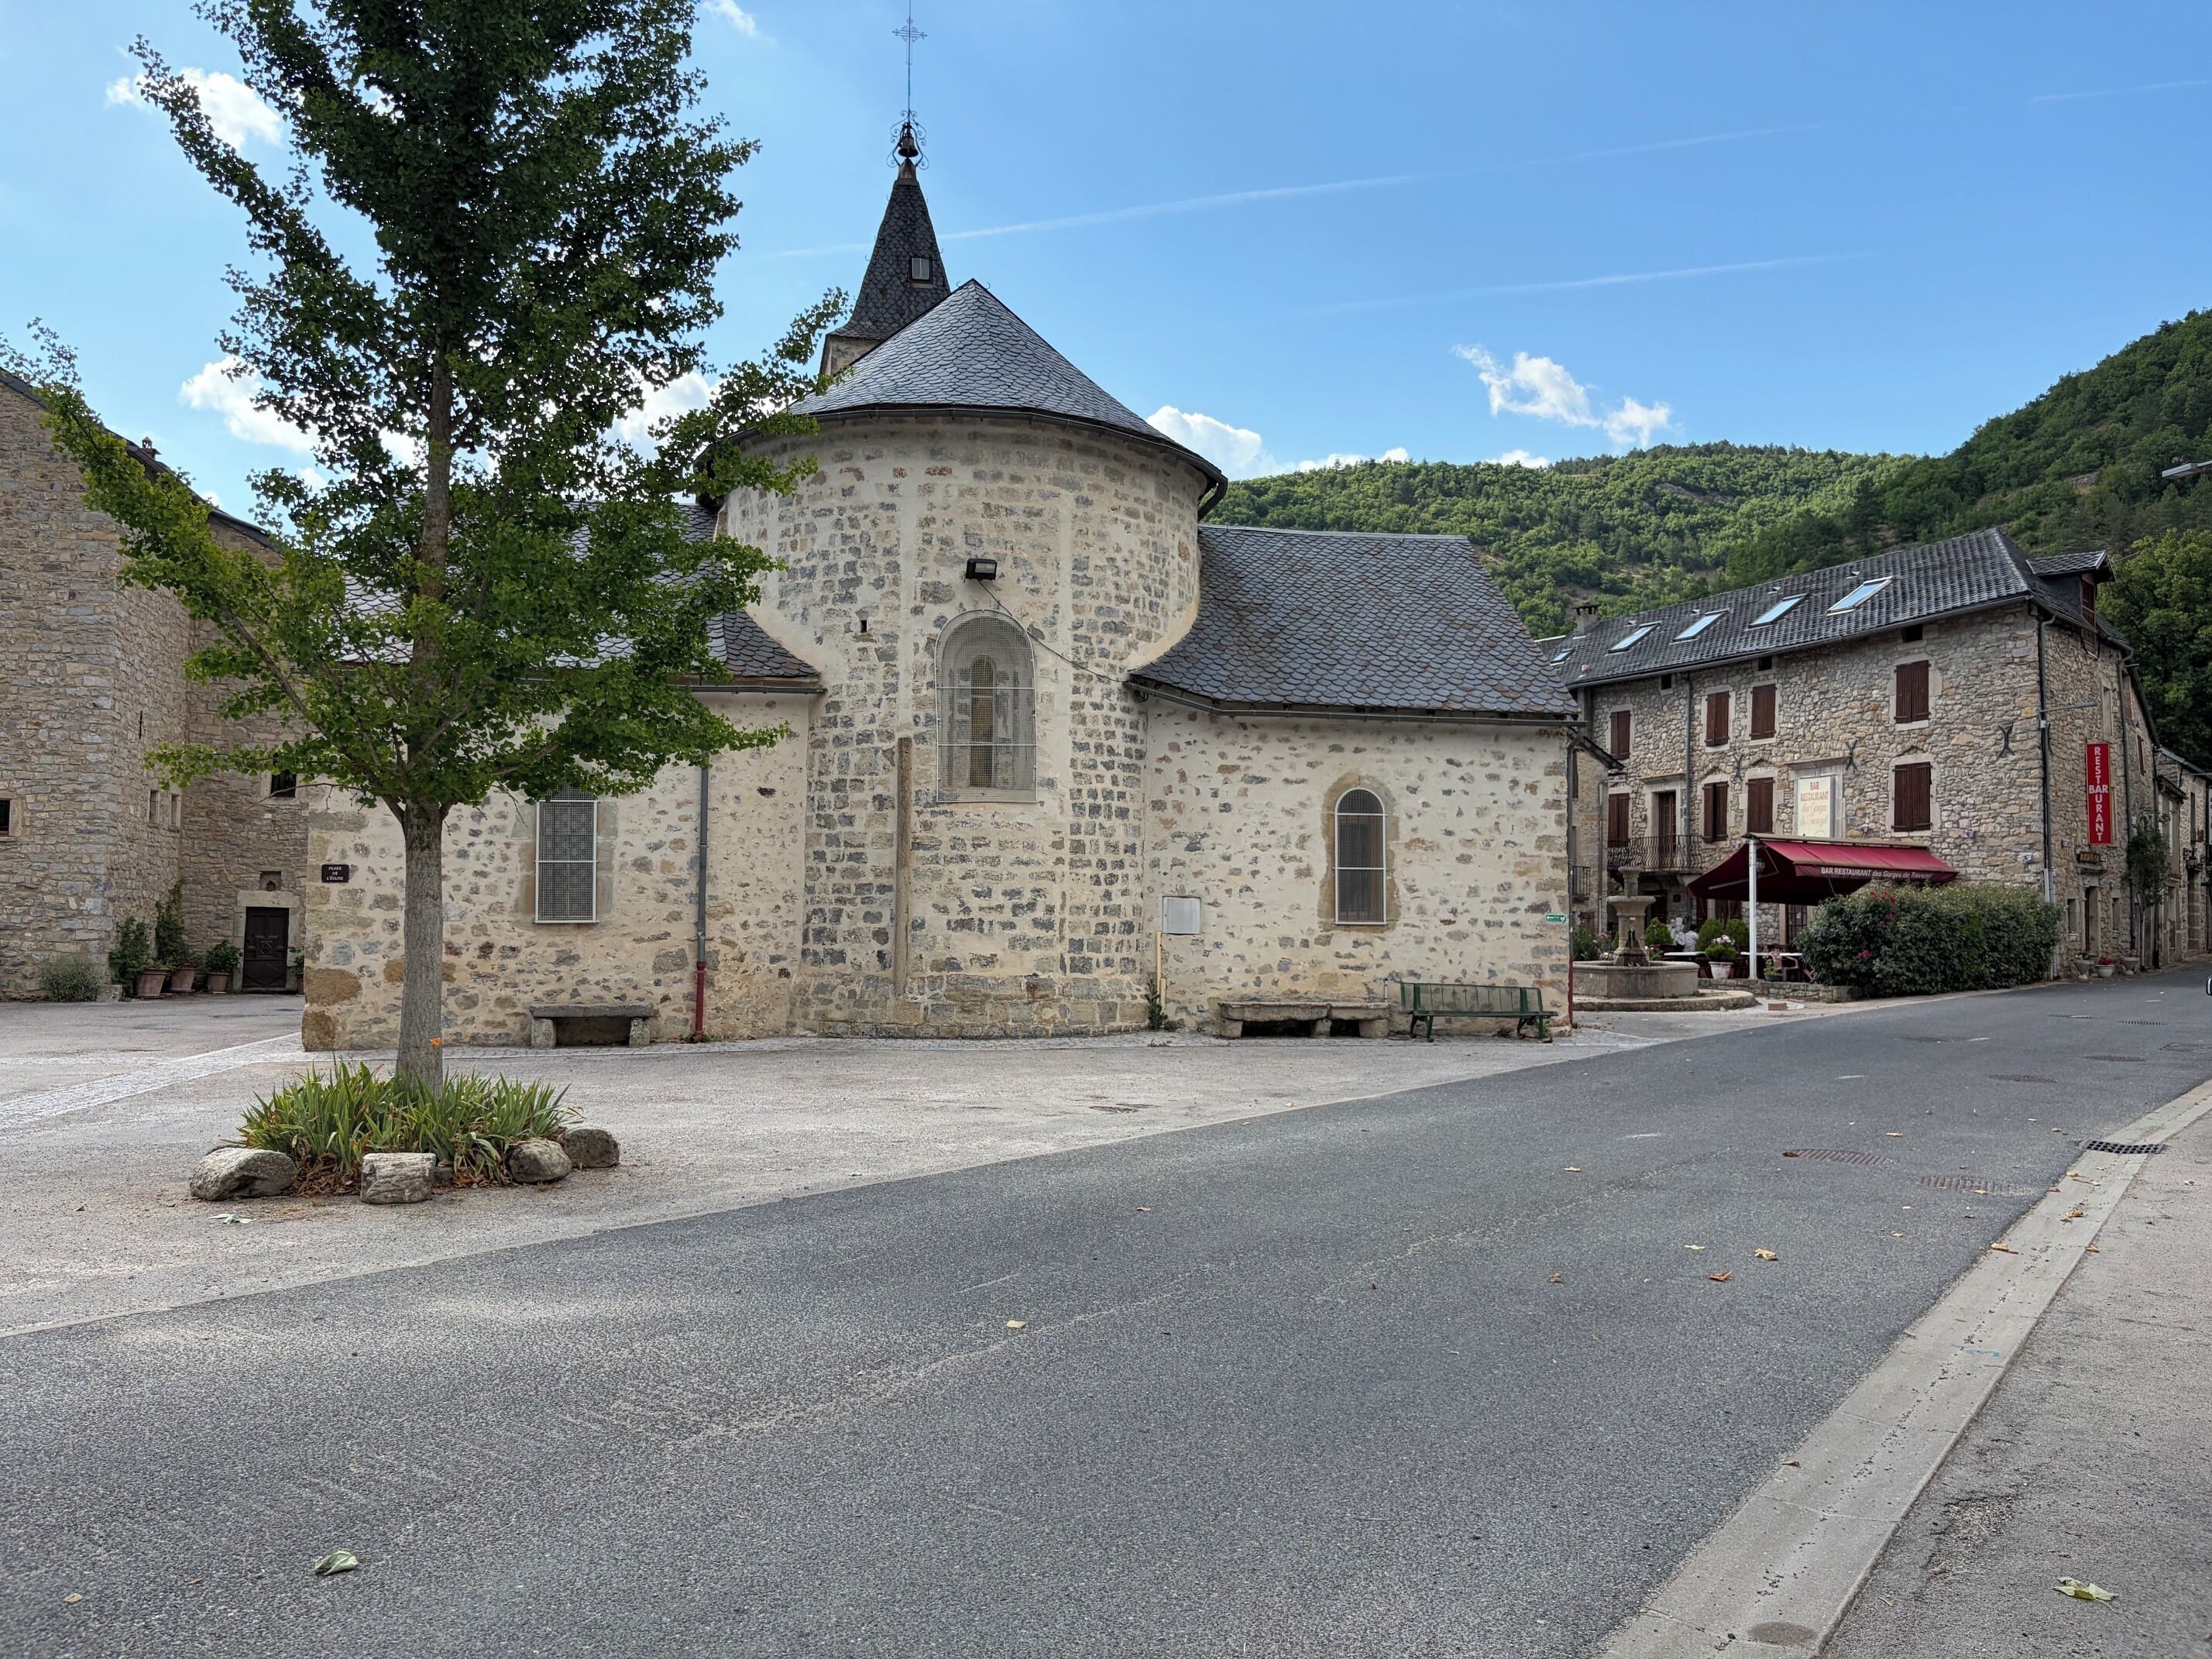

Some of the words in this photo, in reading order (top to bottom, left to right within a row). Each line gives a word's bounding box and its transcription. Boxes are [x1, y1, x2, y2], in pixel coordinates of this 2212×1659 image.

[1809, 781, 1819, 791] BAR
[2088, 785, 2109, 794] BAR
[1800, 791, 1829, 802] RESTAURANT
[2094, 747, 2104, 842] RESTAURANT
[1834, 867, 1871, 876] RESTAURANT
